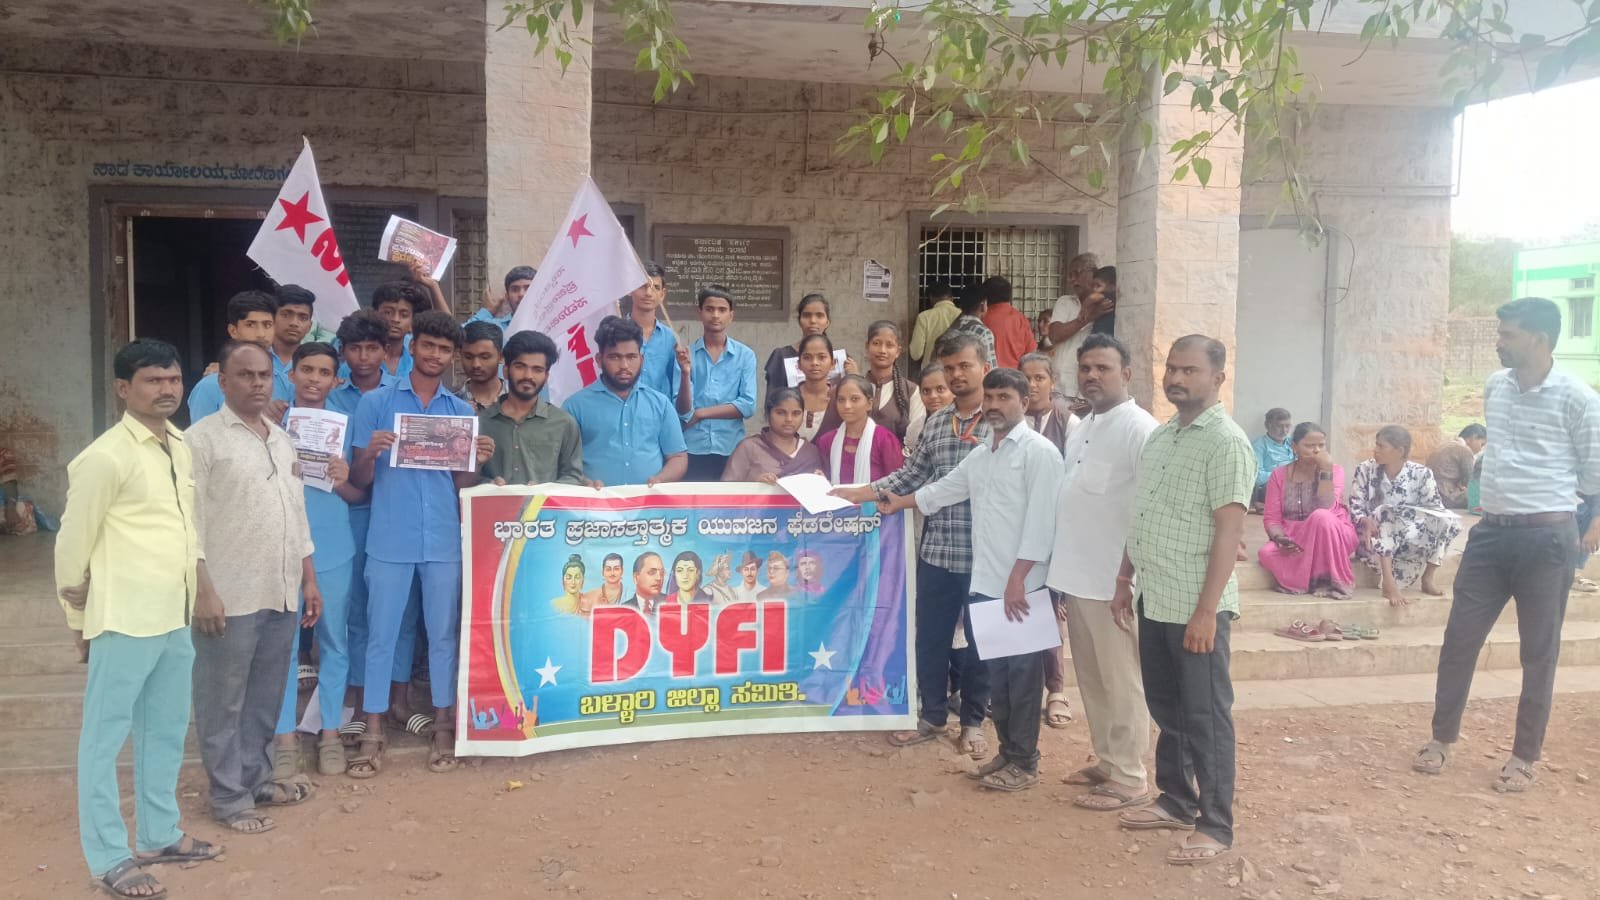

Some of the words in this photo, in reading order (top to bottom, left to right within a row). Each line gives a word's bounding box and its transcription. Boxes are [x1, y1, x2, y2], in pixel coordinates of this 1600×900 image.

[93, 161, 130, 177] ನಾಡ
[494, 519, 556, 542] ಭಾರತ
[565, 516, 688, 547] ಪ್ರಜಾಸತ್ತಾತ್ಮಕ
[698, 515, 778, 536] ಯುವಜನ
[787, 511, 882, 537] ಫೆಡರೇಷನ್
[590, 601, 787, 684] DYFI
[580, 690, 656, 724] ಬಳ್ಳಾರಿ
[667, 687, 721, 713] ಜಿಲ್ಲಾ
[731, 681, 807, 704] ಸಮಿತಿ.
